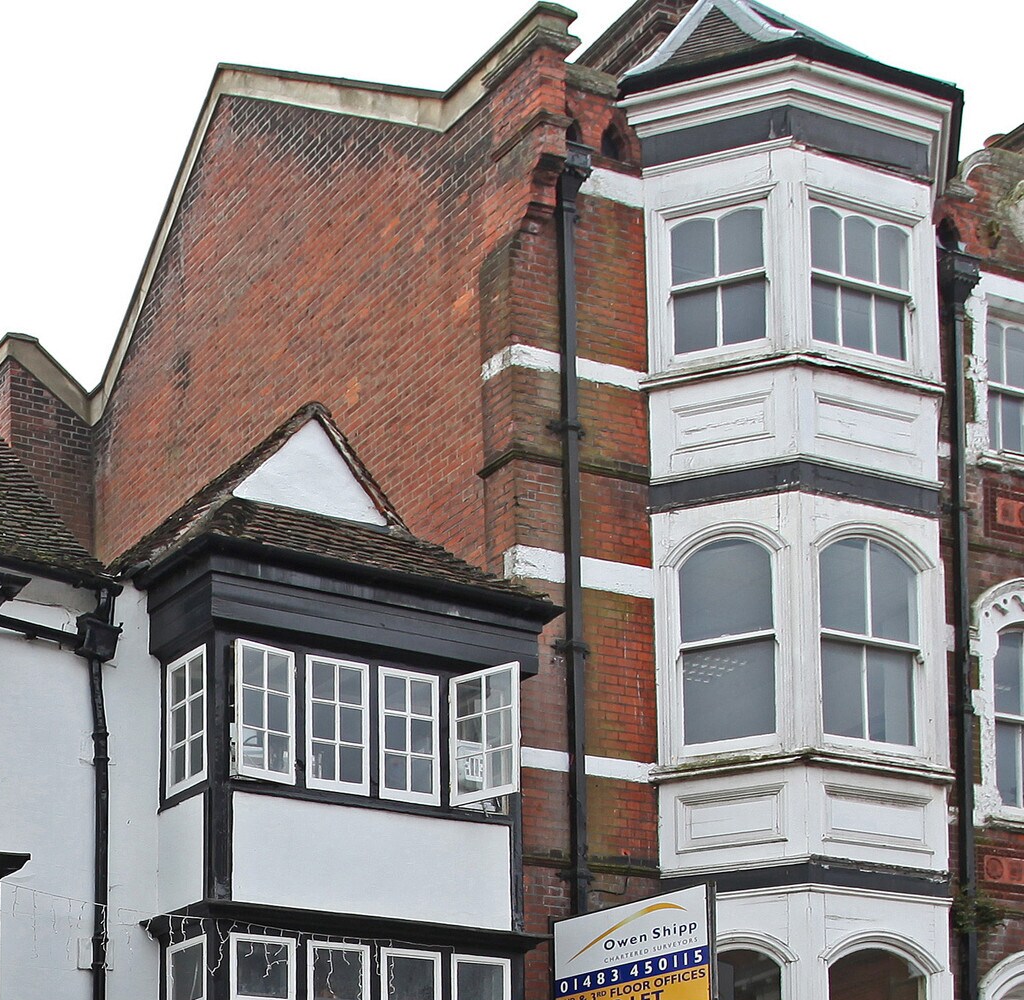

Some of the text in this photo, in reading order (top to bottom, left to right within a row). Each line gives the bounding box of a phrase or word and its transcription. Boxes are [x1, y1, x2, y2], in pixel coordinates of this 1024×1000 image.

[604, 922, 697, 951] Owen Shipp
[604, 936, 698, 964] CHARTERED SURVEYORS
[560, 949, 703, 994] 01483 450115
[610, 980, 651, 998] FLOOR
[654, 968, 706, 988] OFFICES
